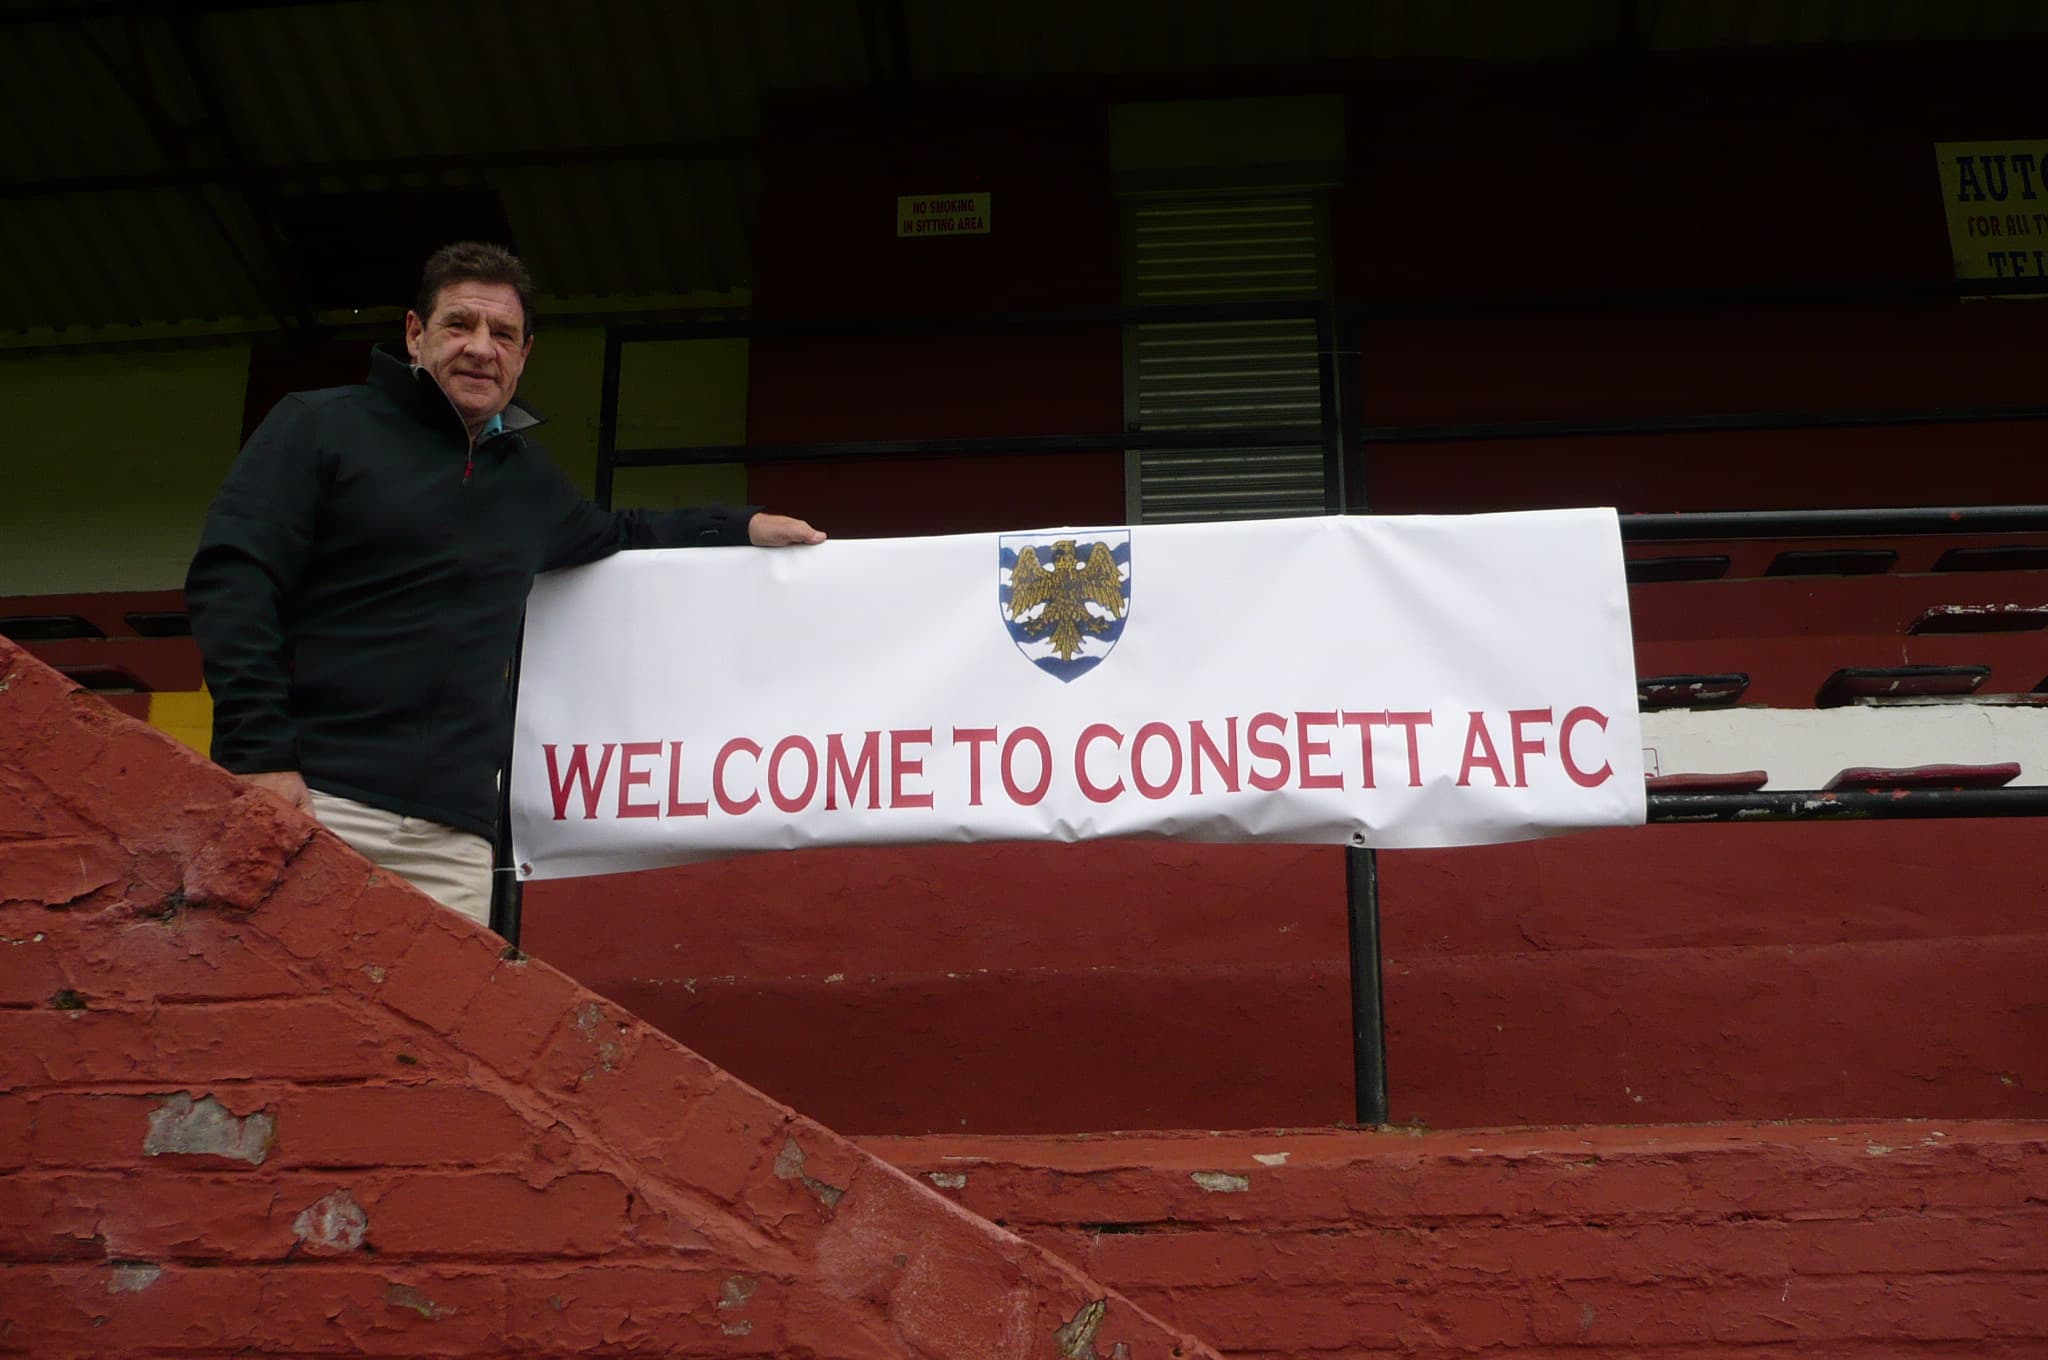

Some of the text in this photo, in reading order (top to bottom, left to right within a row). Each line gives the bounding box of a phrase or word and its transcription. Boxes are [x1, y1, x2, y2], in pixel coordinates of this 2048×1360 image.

[912, 199, 975, 215] NO SMOKING
[903, 215, 984, 233] IN SITTING AREA
[542, 704, 1614, 821] WELCOME TO CONSETT AFC
